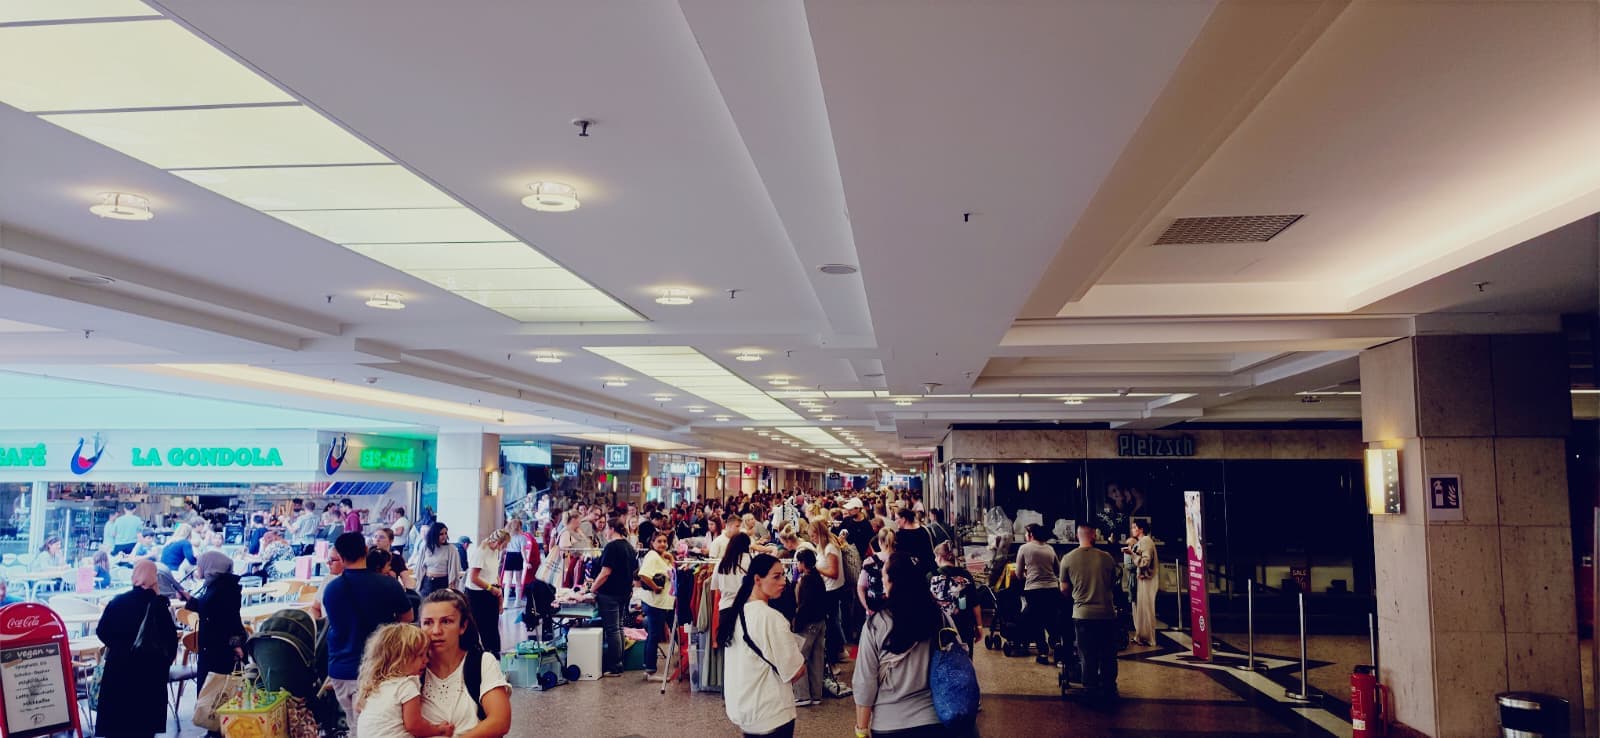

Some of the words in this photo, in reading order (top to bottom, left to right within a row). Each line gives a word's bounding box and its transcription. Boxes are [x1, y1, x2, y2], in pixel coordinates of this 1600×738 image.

[1119, 434, 1193, 456] Pletzsch
[131, 447, 162, 467] LA
[167, 447, 283, 467] GONDOLA
[361, 447, 414, 468] EIS-CAFÉ
[7, 615, 40, 629] Coca-Cola
[16, 648, 44, 660] vegan
